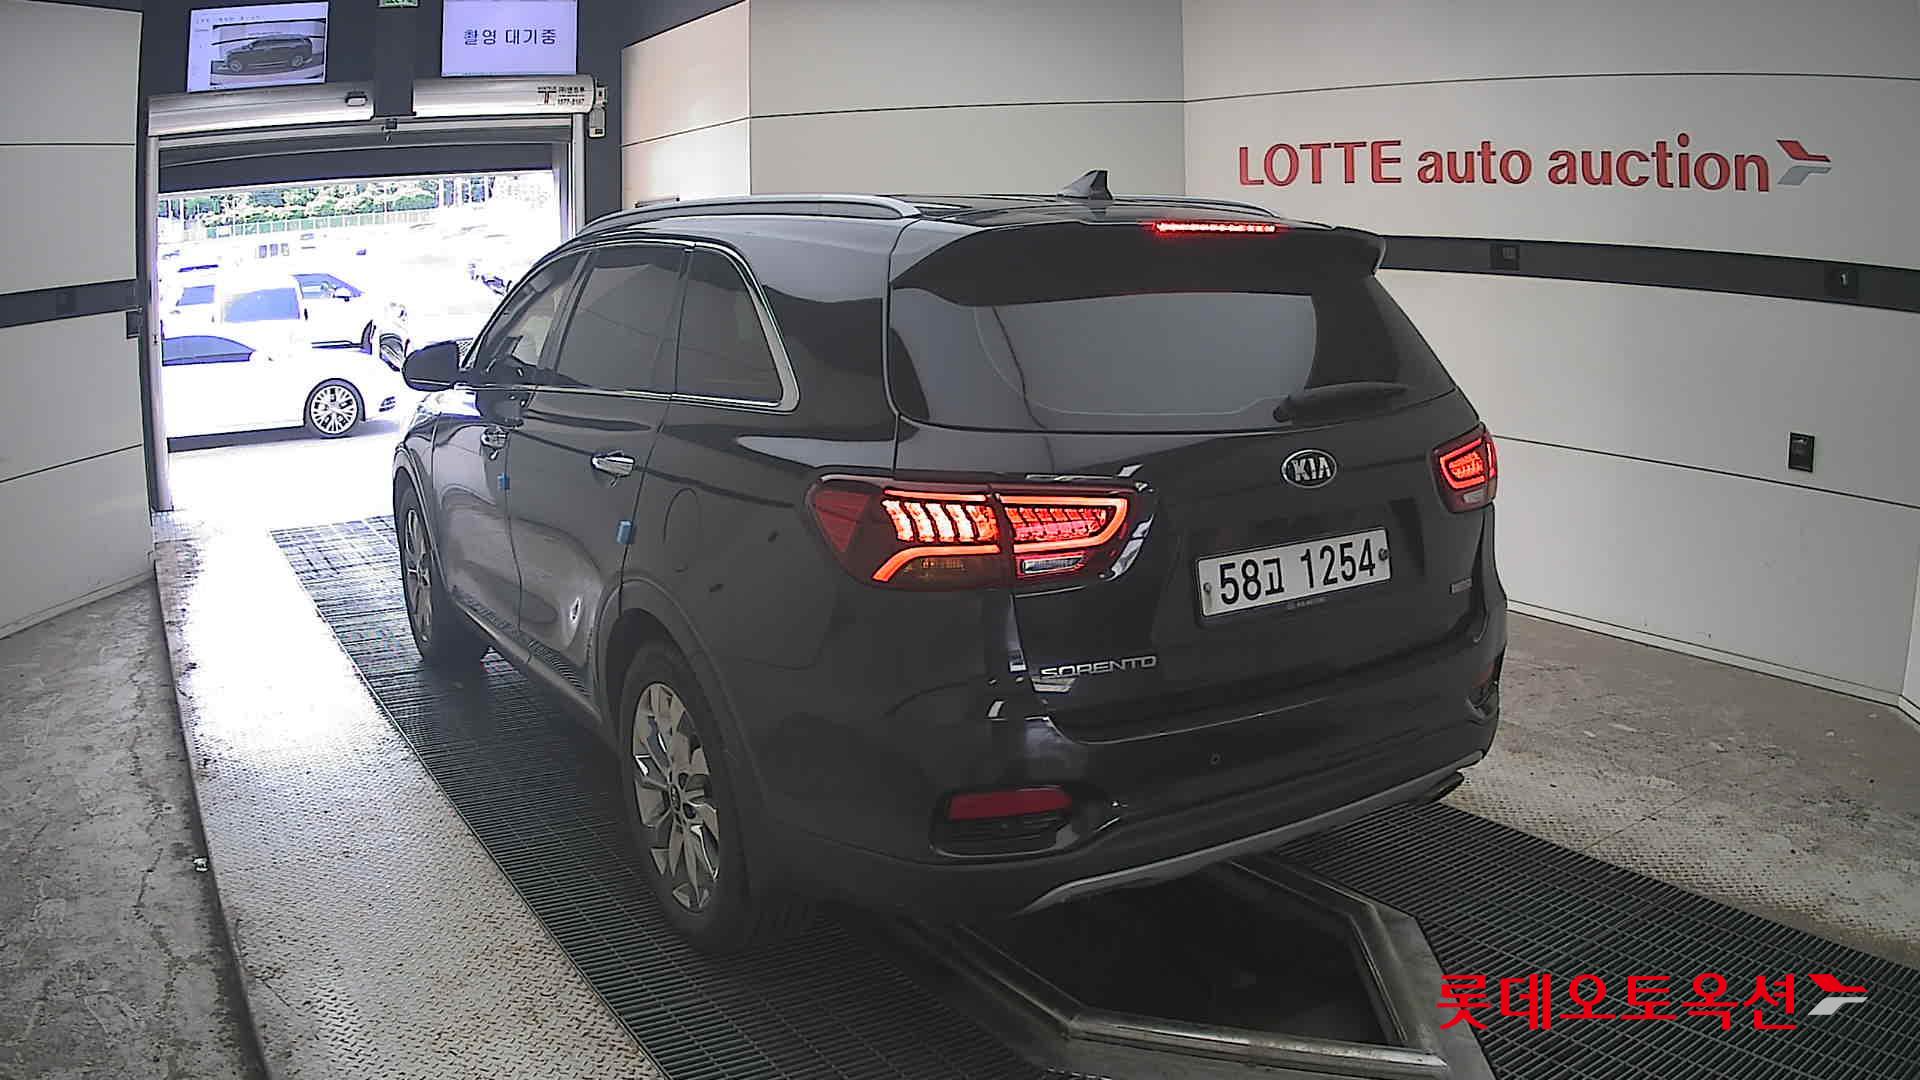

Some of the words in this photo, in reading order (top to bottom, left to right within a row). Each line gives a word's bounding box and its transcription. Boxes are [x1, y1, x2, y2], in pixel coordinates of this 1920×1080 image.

[464, 29, 497, 46] 촬영
[505, 28, 557, 46] 대기중
[1238, 140, 1402, 187] LOTTE
[1416, 140, 1533, 186] auto
[1547, 132, 1770, 193] auction
[1290, 456, 1331, 481] KIA
[1218, 557, 1286, 605] 58고
[1300, 538, 1376, 589] 1254
[1040, 655, 1157, 679] SORENTO
